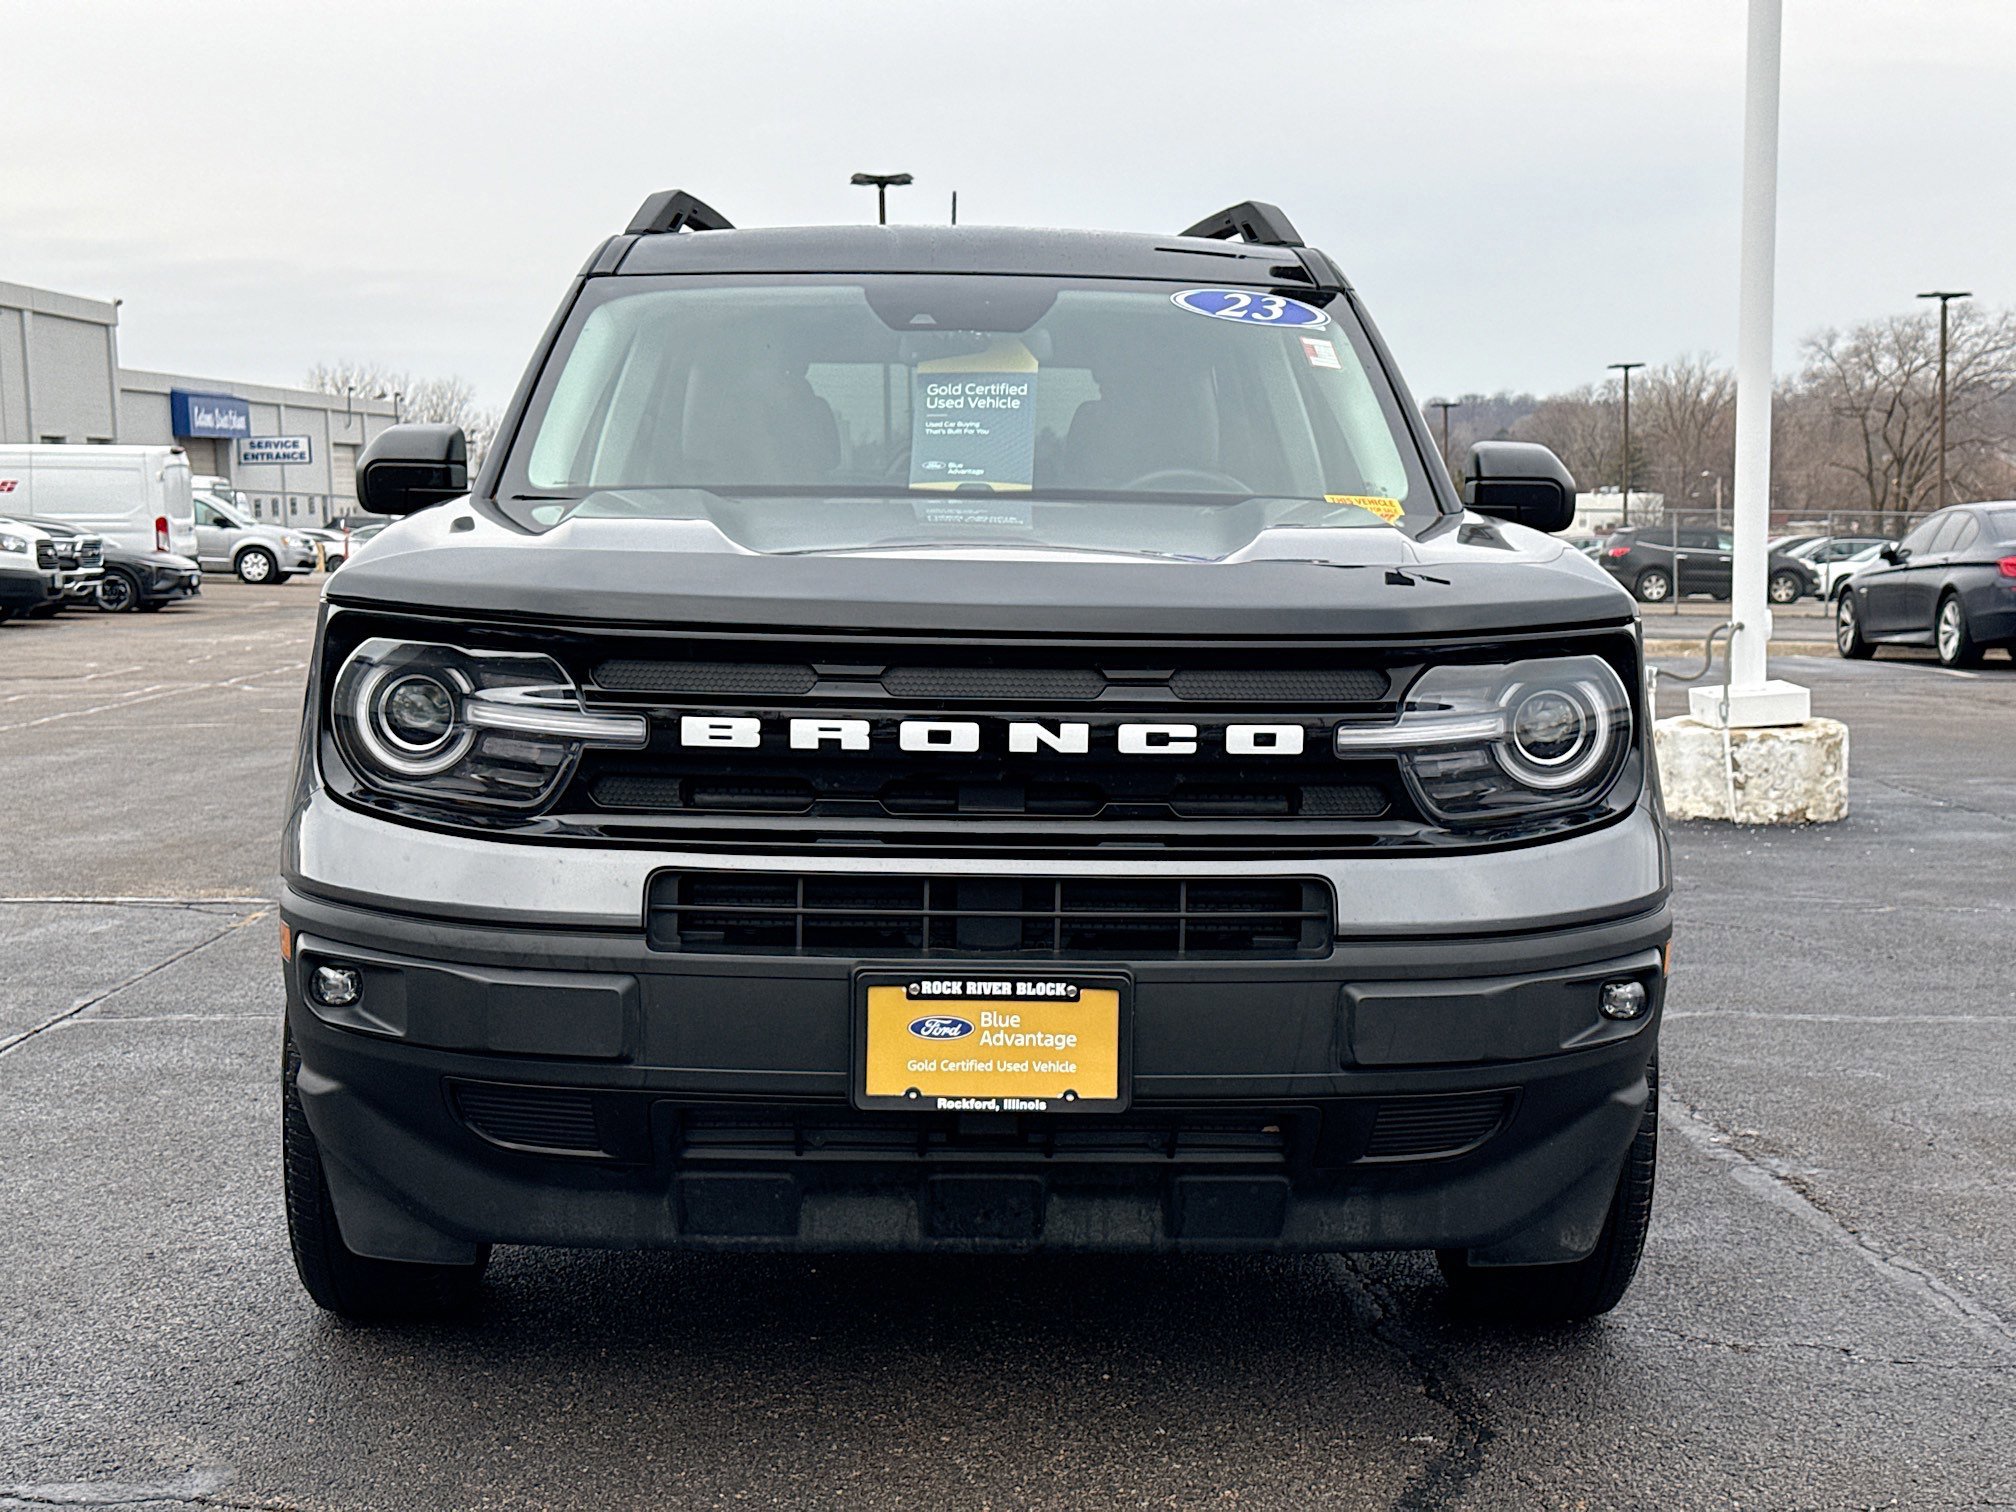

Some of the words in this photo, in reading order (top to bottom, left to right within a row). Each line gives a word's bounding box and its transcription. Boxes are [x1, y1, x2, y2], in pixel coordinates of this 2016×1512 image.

[1215, 293, 1287, 321] 23
[927, 383, 962, 396] Gold
[965, 383, 1028, 396] Certified
[926, 397, 964, 409] Used
[968, 397, 1021, 409] Vehicle
[249, 439, 300, 450] SERVICE
[243, 450, 307, 461] ENTRANCE
[1354, 497, 1396, 508] VEHICLE
[680, 715, 1305, 755] BRONCO
[921, 980, 962, 995] ROCK
[966, 981, 1012, 996] RIVER
[1016, 982, 1067, 997] BLOCK
[980, 1011, 1021, 1028] Blue
[920, 1018, 962, 1037] Ford
[979, 1029, 1077, 1050] Advantage
[907, 1059, 937, 1072] Gold
[940, 1059, 993, 1072] Certified
[996, 1060, 1029, 1073] Used
[1032, 1060, 1077, 1073] Vehicle
[937, 1097, 1001, 1112] Rockford,
[1003, 1098, 1047, 1111] Illinois
